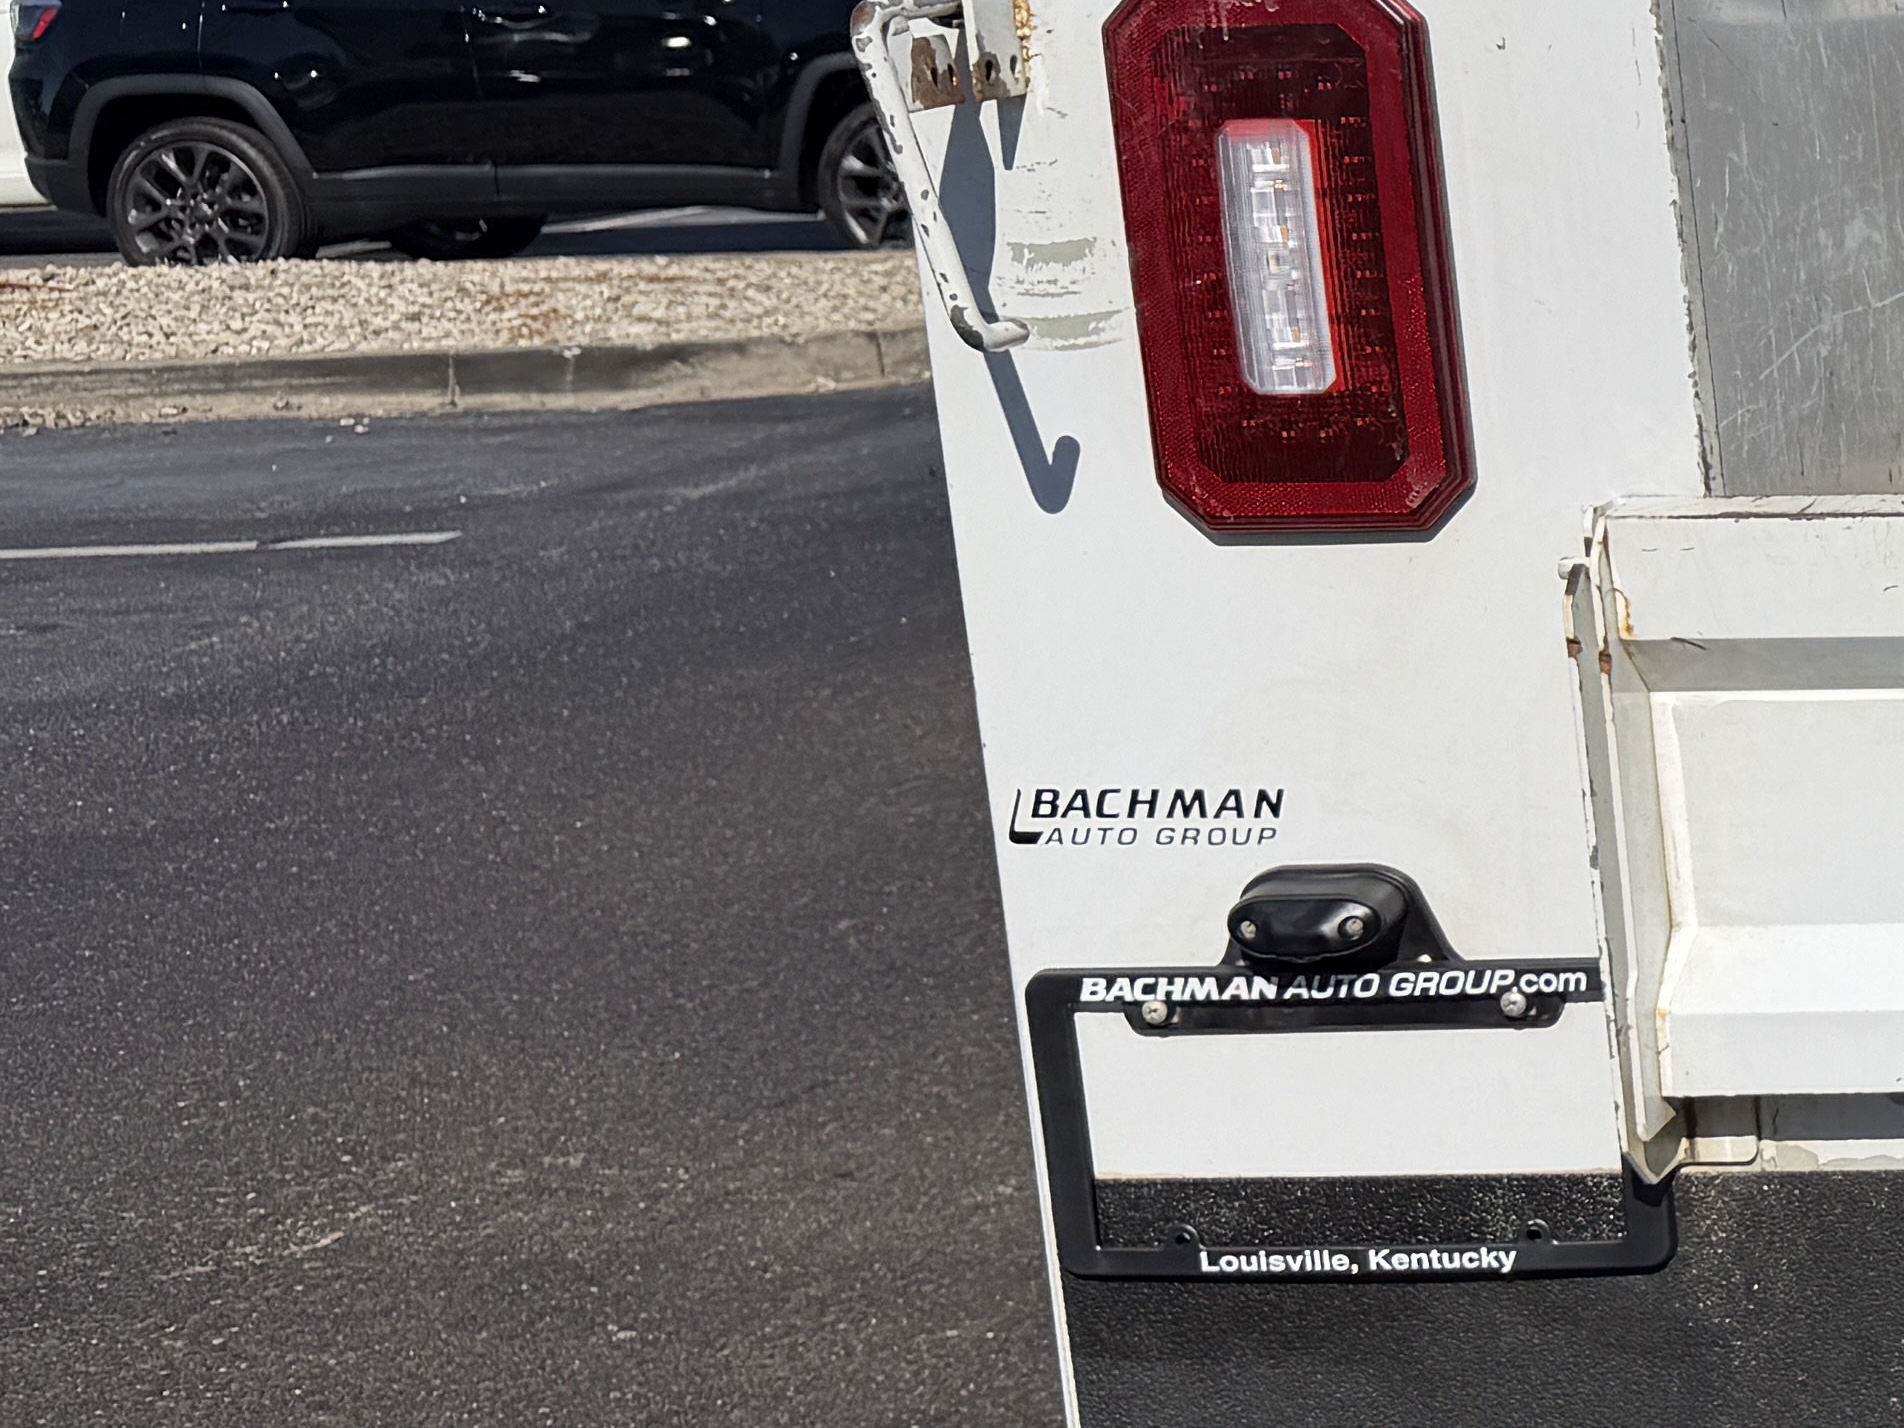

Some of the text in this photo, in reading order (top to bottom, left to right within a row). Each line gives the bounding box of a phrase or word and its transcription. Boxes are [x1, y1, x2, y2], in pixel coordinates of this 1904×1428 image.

[1031, 788, 1285, 819] BACHMAN
[1045, 827, 1277, 845] AUTO GROUP
[1080, 974, 1278, 1002] BACHMAN
[1284, 972, 1381, 999] AUTO
[1200, 1247, 1517, 1275] Louisville, Kentucky
